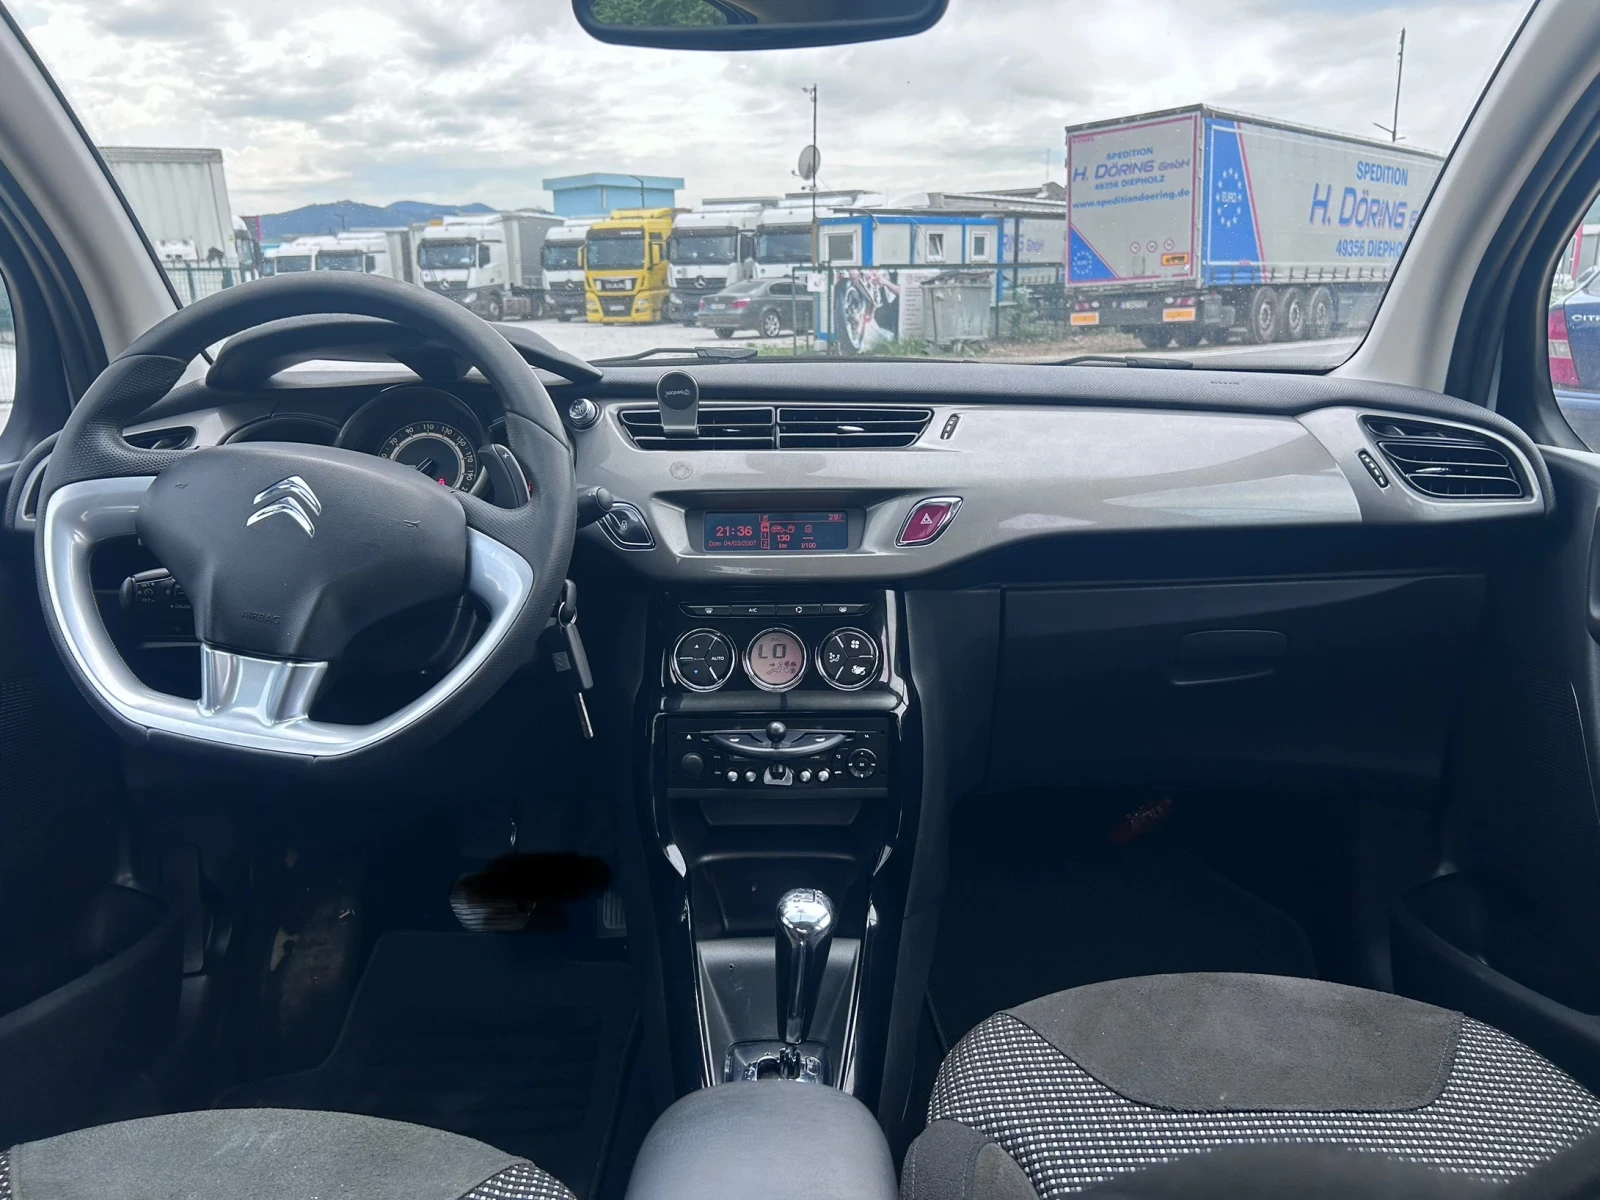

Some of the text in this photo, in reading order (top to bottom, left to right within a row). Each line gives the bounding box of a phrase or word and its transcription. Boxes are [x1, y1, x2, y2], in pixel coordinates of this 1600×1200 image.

[1106, 147, 1154, 161] SPEDITION
[1072, 166, 1089, 182] H.
[1094, 160, 1156, 180] DÖRING
[1356, 160, 1409, 186] SPEDITION
[1094, 175, 1166, 191] 49356 DIEPHOLZ
[1309, 183, 1332, 225] H.
[1336, 239, 1365, 257] 49356
[441, 426, 453, 435] 130
[389, 437, 398, 446] 70
[456, 436, 467, 447] 150
[466, 451, 474, 463] 170
[466, 470, 474, 481] 190
[716, 525, 753, 537] 21:36
[241, 609, 281, 625] AIRBAG
[758, 644, 787, 659] LO
